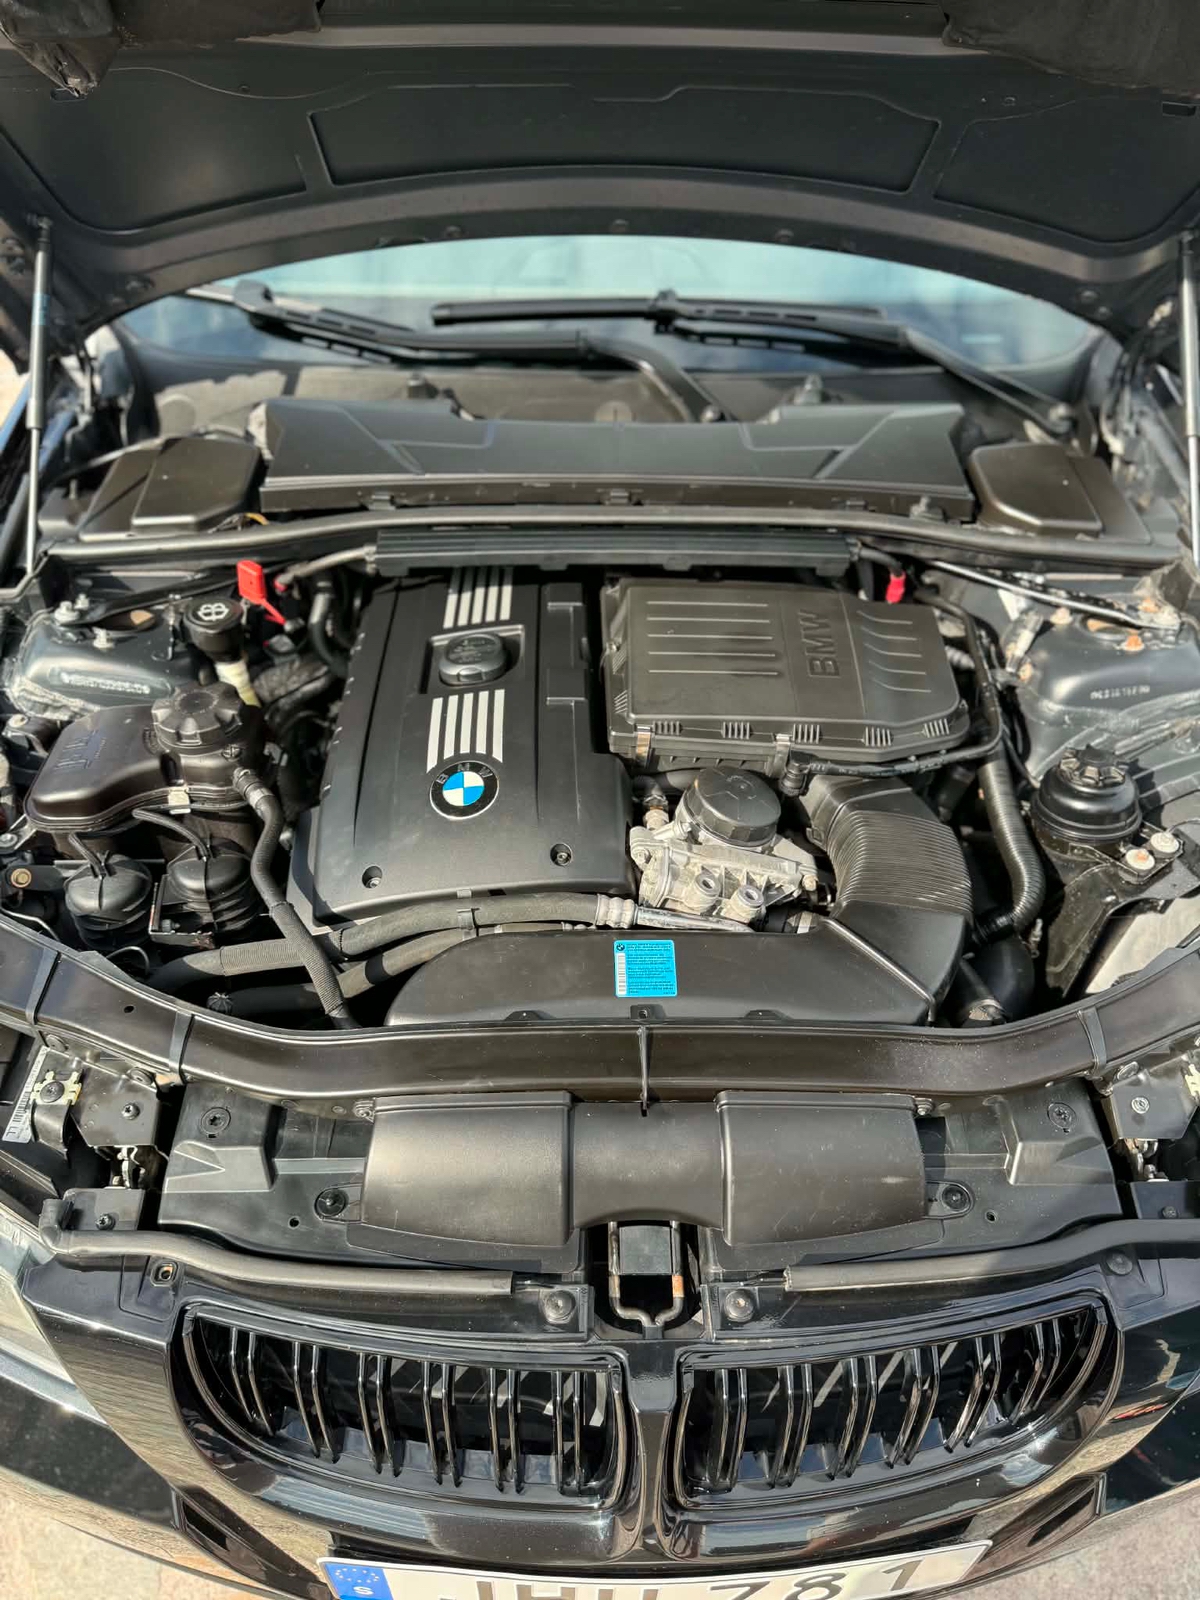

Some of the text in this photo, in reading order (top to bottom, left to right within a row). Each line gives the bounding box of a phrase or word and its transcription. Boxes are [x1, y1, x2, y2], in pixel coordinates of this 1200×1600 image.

[798, 610, 841, 678] BMW
[436, 762, 493, 785] BMW
[353, 1586, 374, 1596] S
[709, 1559, 923, 1600] 781
